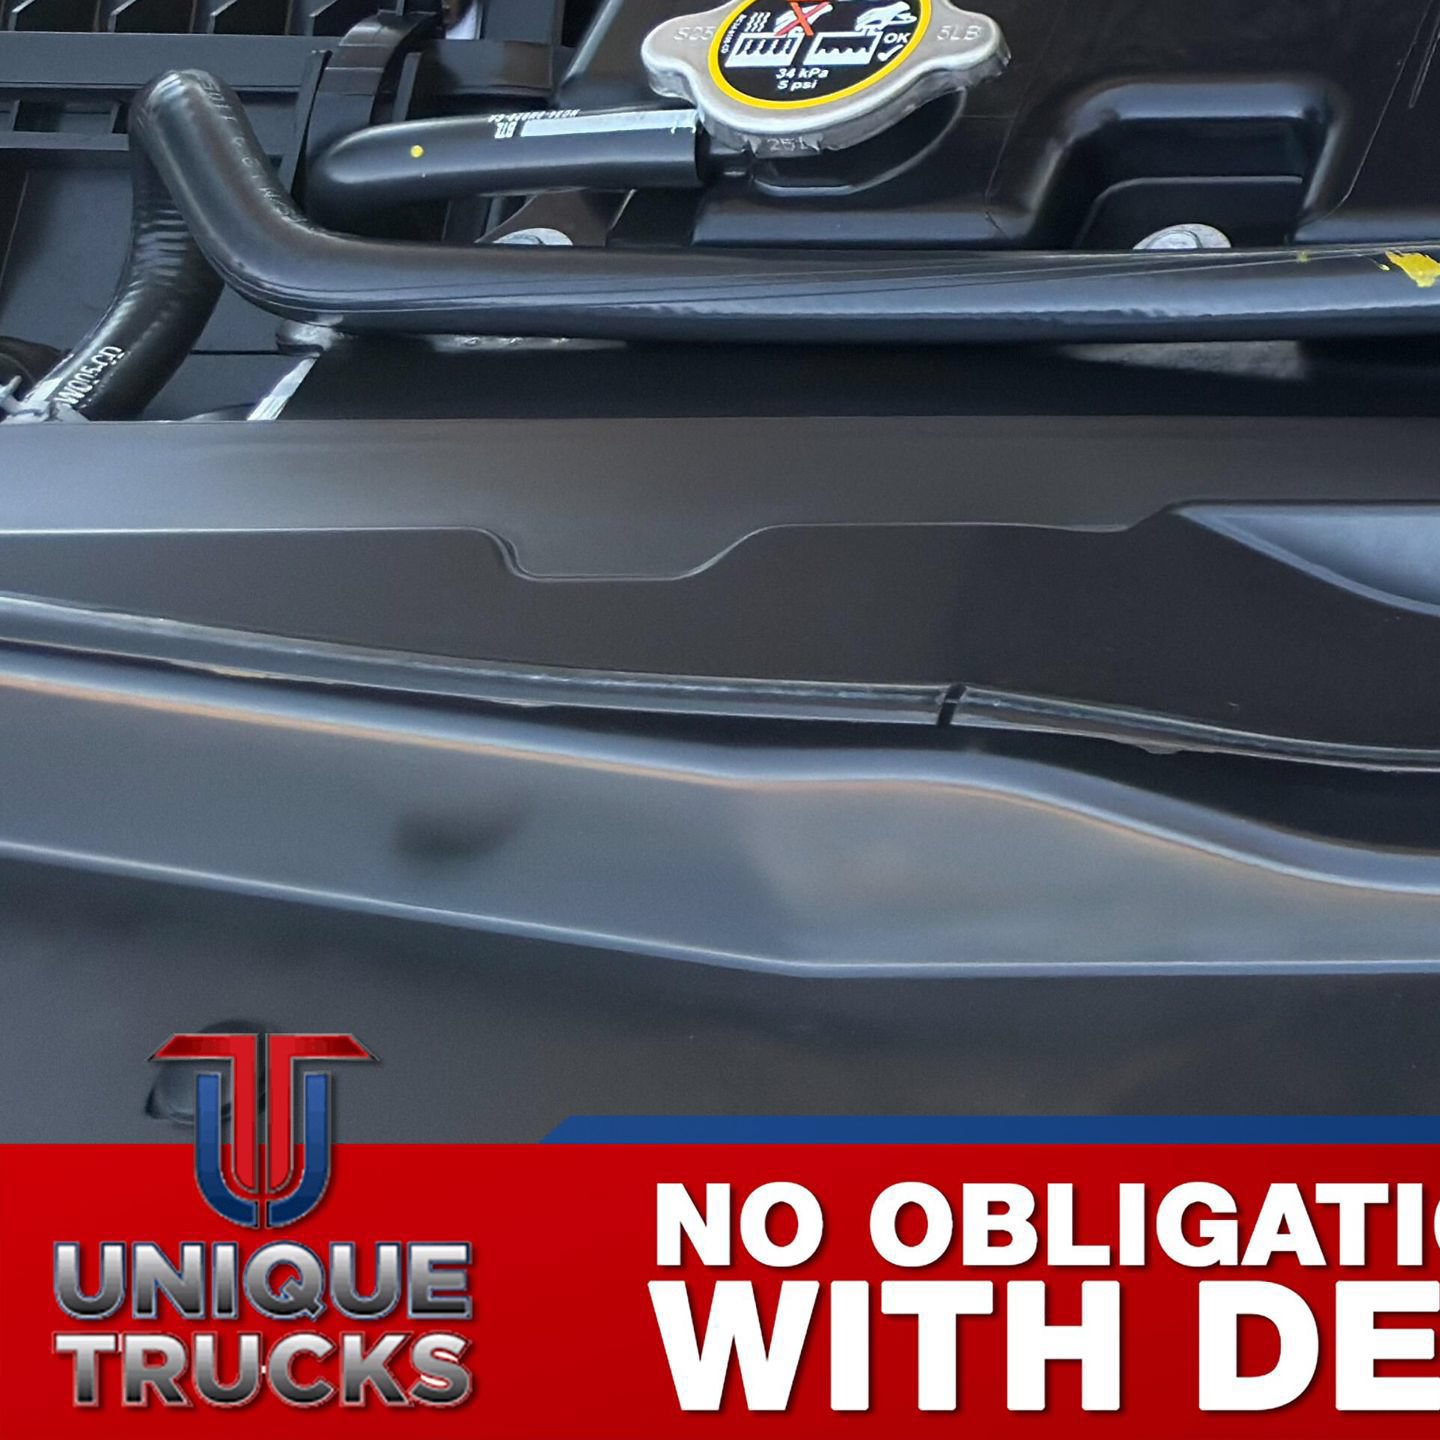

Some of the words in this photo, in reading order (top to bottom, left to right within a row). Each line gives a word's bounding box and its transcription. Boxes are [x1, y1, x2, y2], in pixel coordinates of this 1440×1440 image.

[883, 31, 909, 44] OK
[775, 68, 796, 79] 34
[798, 68, 829, 79] kPa
[777, 80, 788, 90] 5
[790, 79, 818, 91] psi
